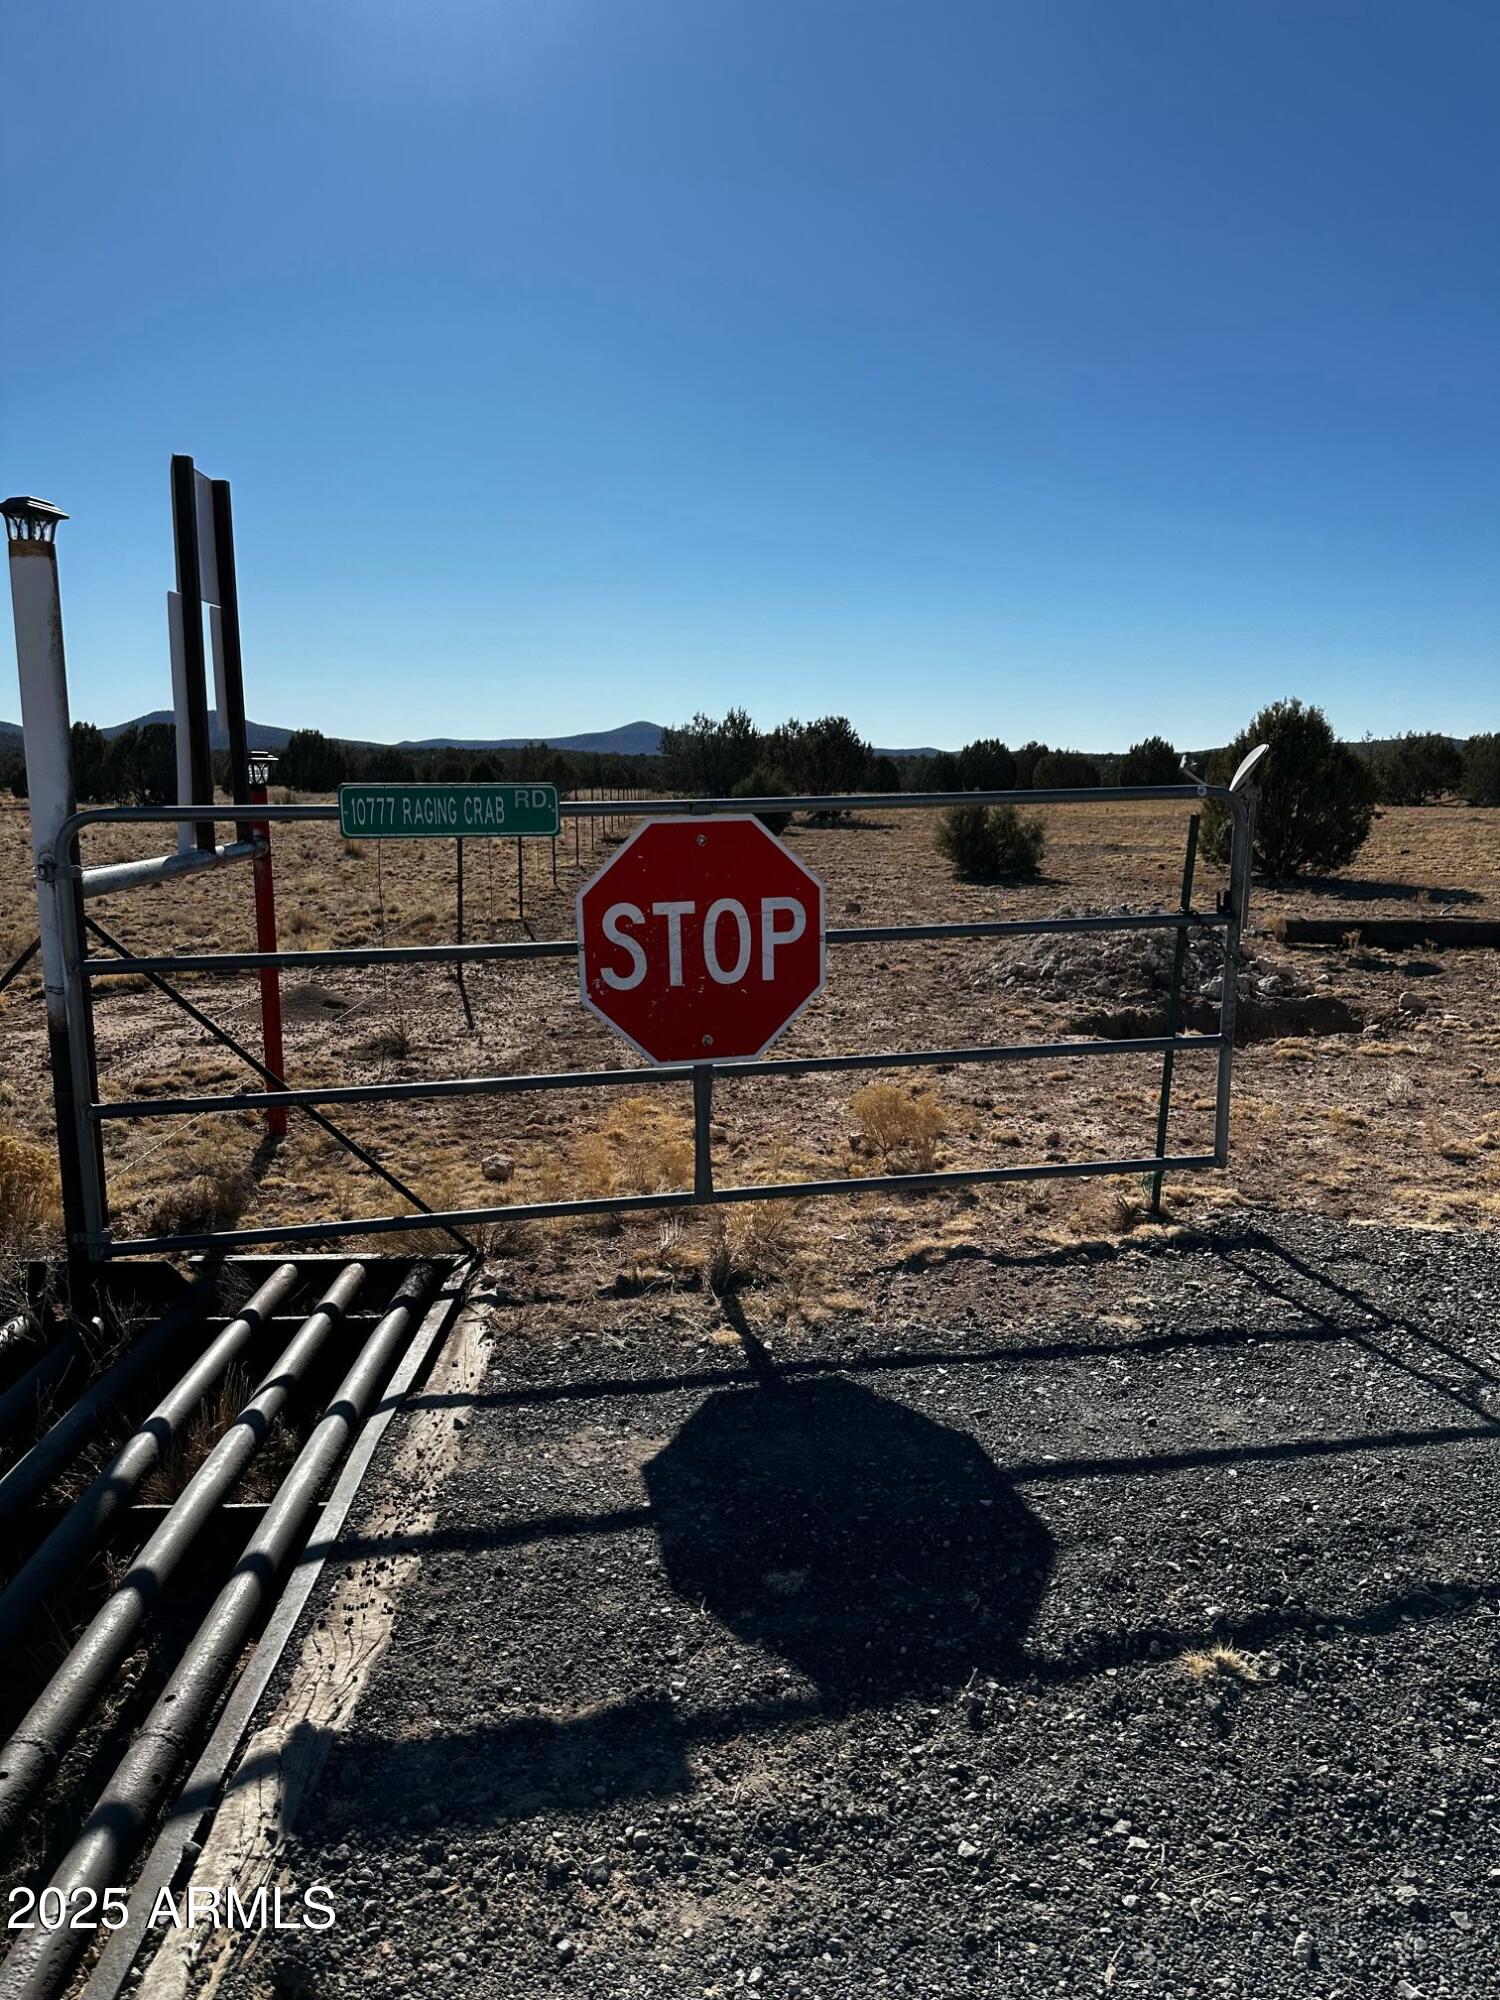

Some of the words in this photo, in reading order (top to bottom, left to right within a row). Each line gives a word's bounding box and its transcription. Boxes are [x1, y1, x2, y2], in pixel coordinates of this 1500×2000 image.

[351, 797, 395, 825] 10777
[402, 797, 456, 825] RAGING
[464, 796, 505, 824] CRAB
[600, 897, 807, 991] STOP
